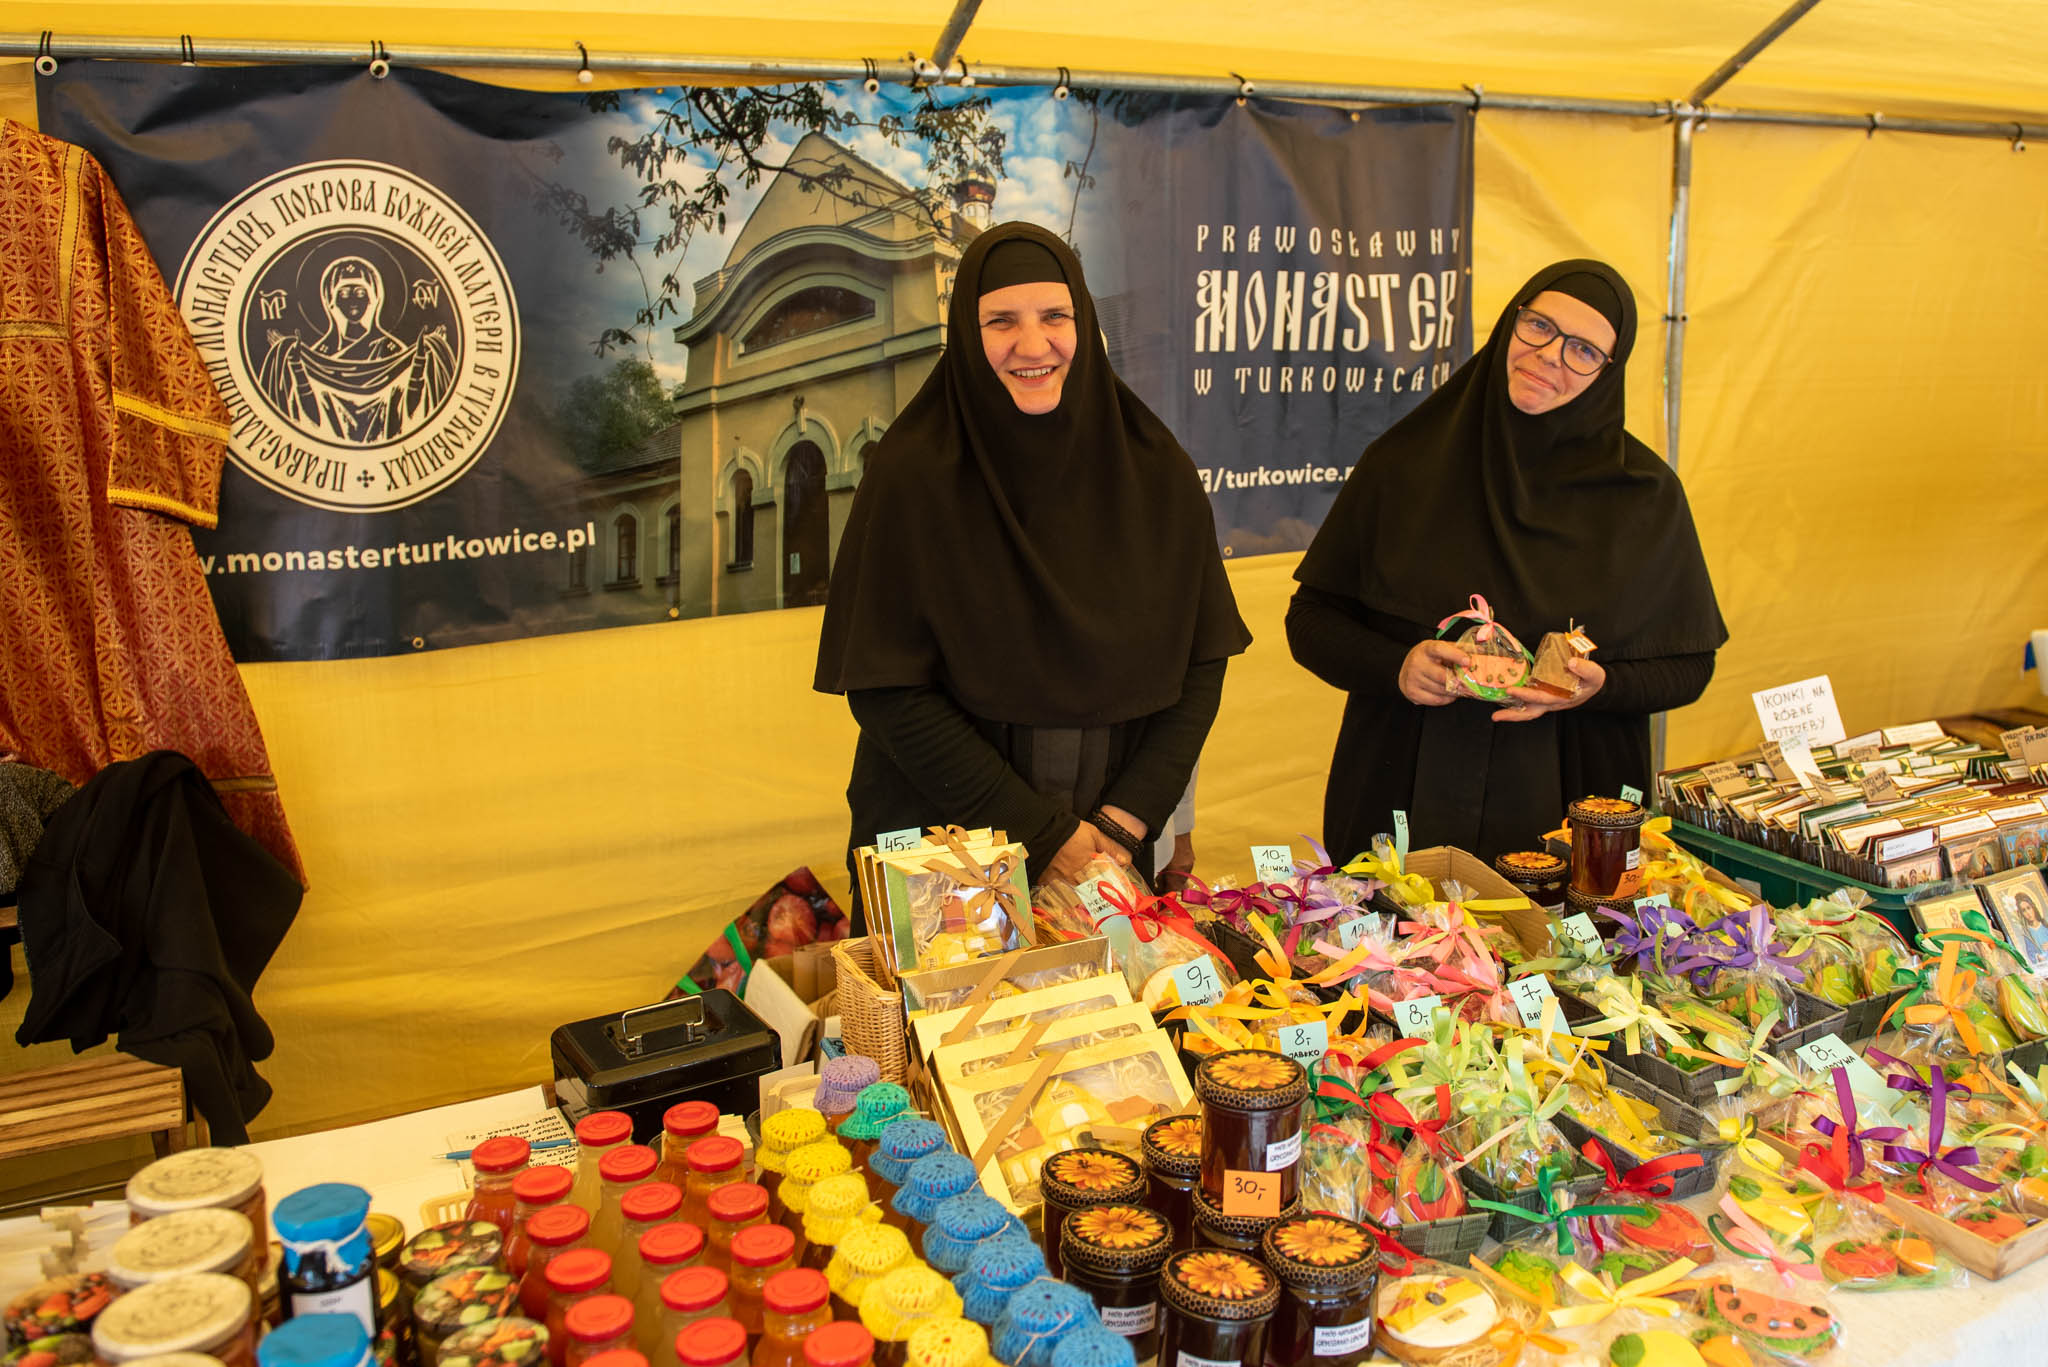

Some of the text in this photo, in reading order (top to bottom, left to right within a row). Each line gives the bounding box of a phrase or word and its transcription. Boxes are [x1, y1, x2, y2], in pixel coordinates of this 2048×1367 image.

[270, 178, 376, 227] ПОКРОВА
[1194, 269, 1458, 353] MONASTER
[1194, 368, 1212, 396] W
[1186, 965, 1211, 990] 9,-
[1409, 1003, 1430, 1026] 8,-
[1294, 1028, 1312, 1046] 8,-
[1234, 1176, 1267, 1200] 30,-
